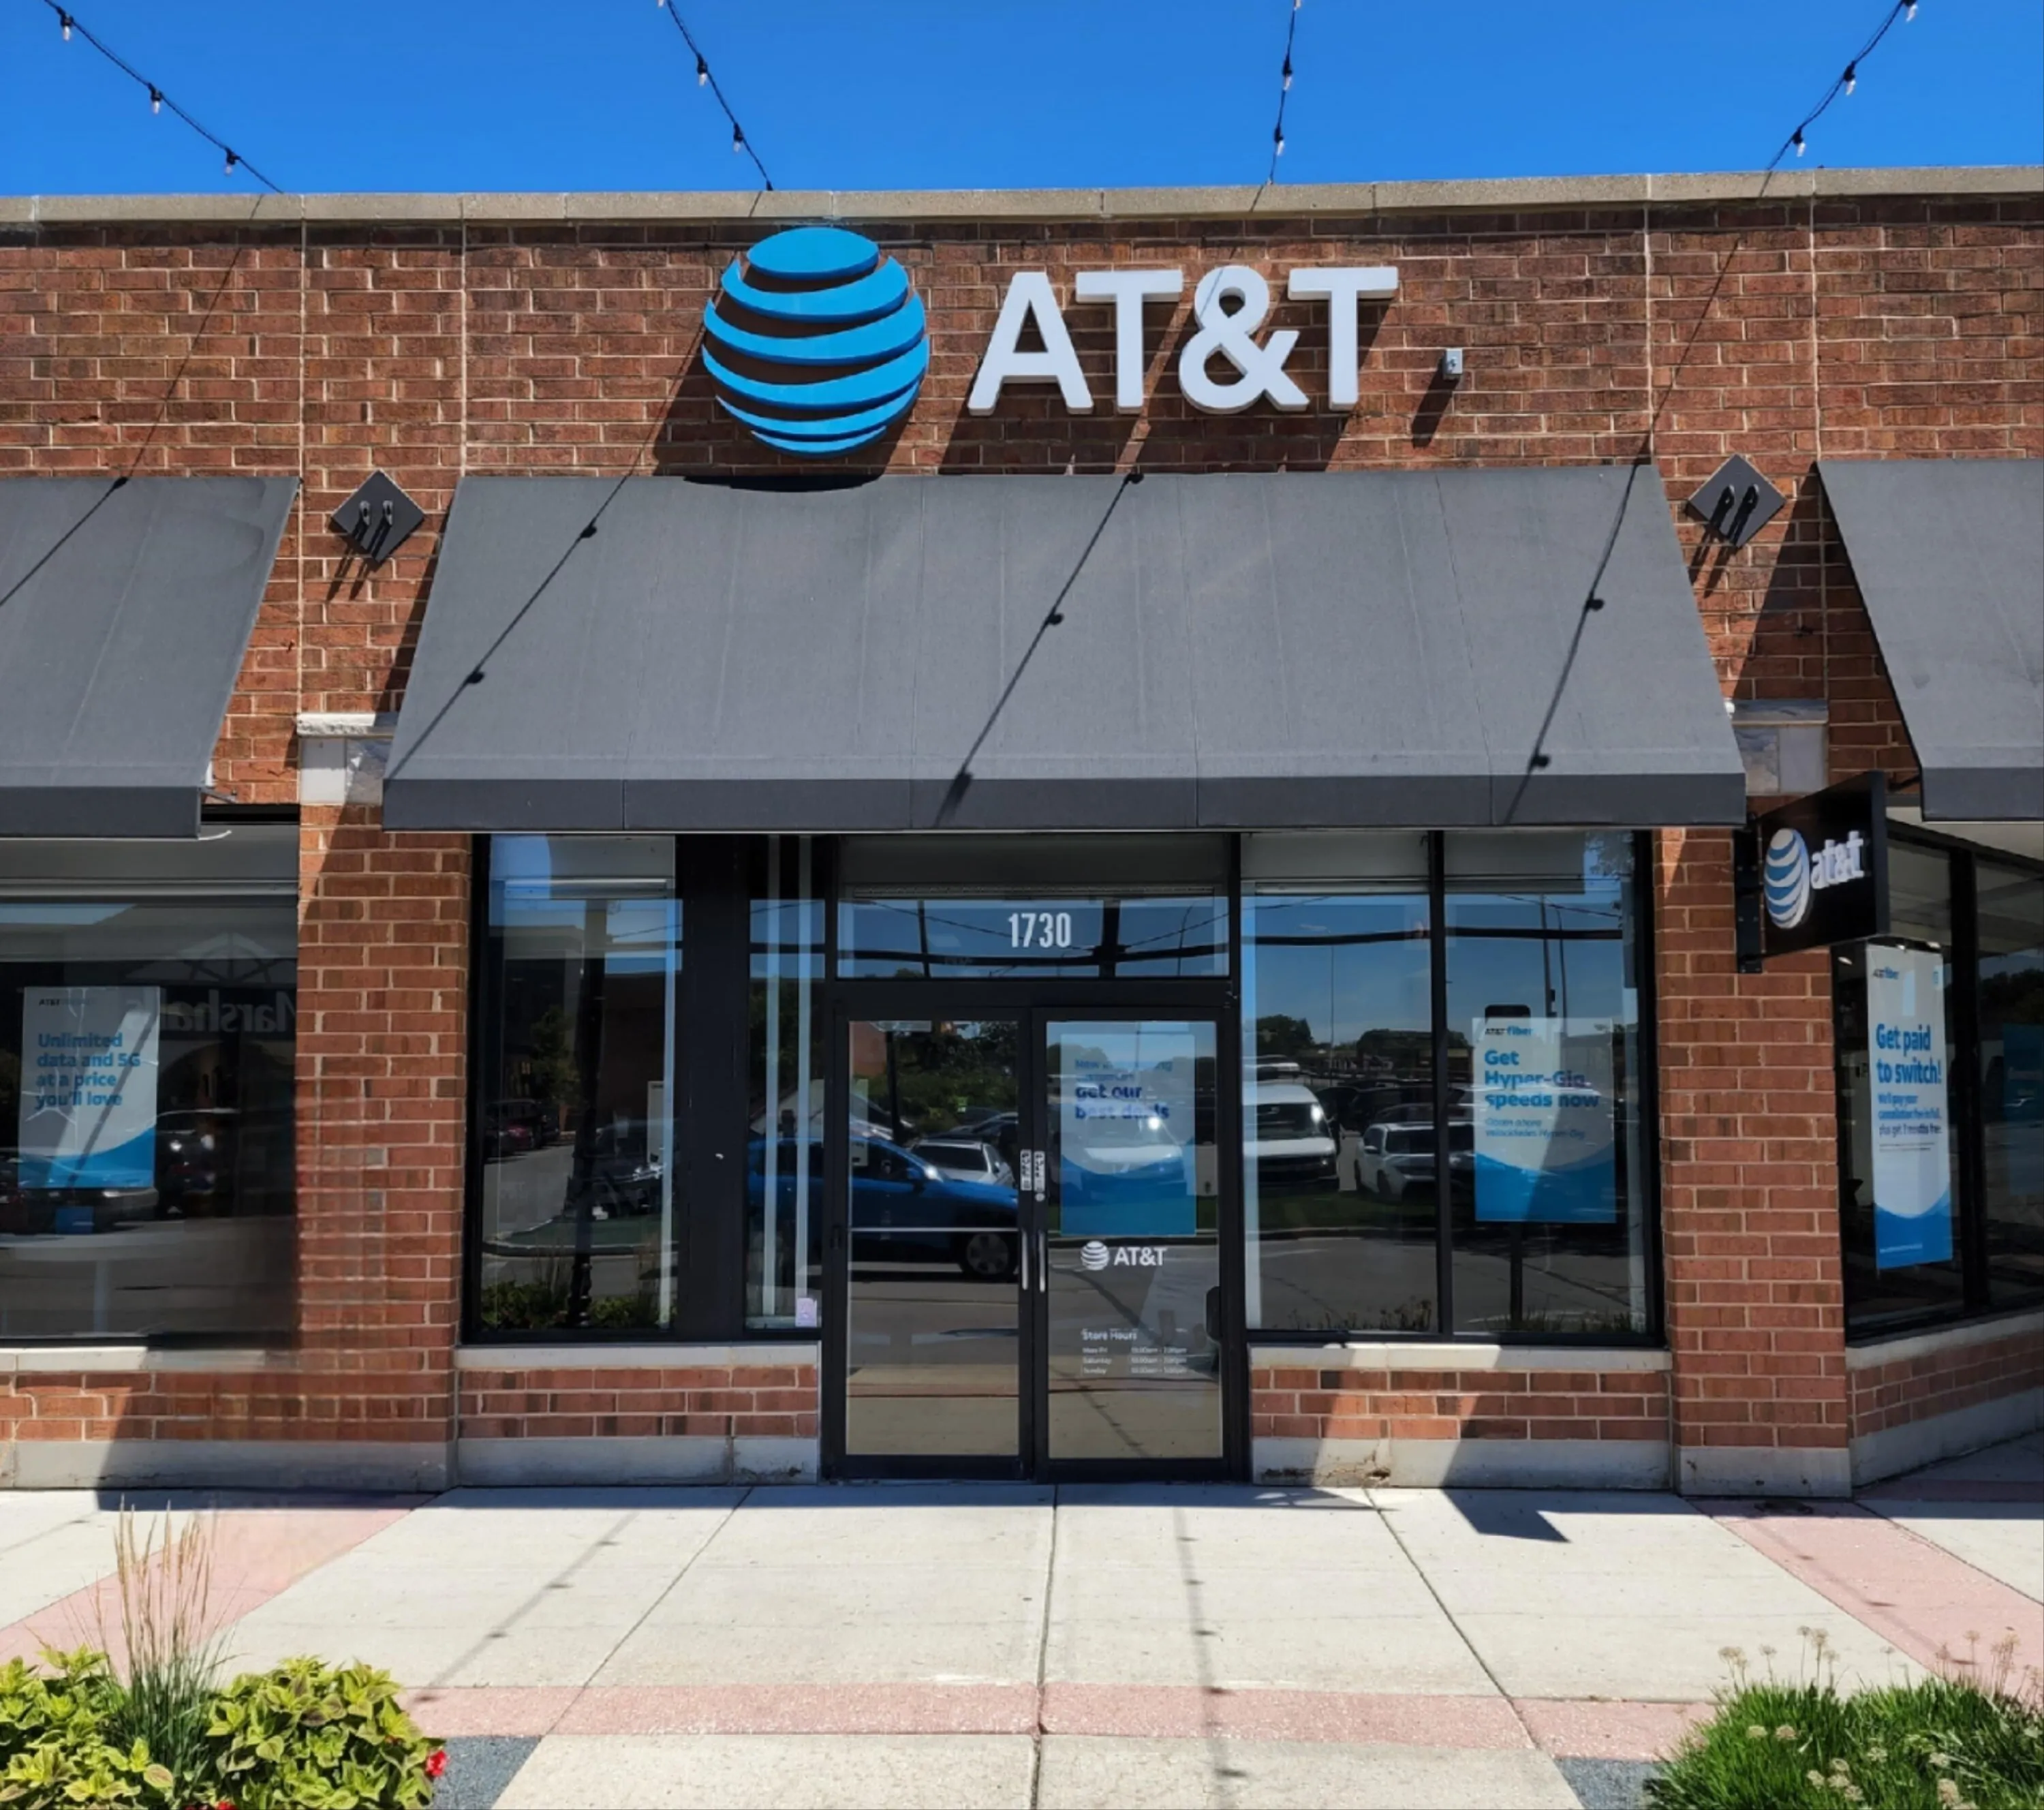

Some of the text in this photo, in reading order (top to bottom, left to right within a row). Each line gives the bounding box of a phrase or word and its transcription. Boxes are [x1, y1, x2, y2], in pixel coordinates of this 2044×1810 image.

[967, 264, 1399, 416] AT&T
[1810, 829, 1865, 890] at&t
[1008, 912, 1072, 949] 1730
[37, 1032, 123, 1048] Unlimited
[1876, 1023, 1932, 1058] Get paid
[36, 1052, 141, 1067] data and 5G
[1484, 1049, 1520, 1066] Get
[1876, 1056, 1942, 1085] to switch!
[36, 1073, 55, 1087] at
[73, 1071, 117, 1090] price
[34, 1091, 123, 1110] you'll love
[1074, 1084, 1142, 1099] Get our
[1485, 1092, 1600, 1109] speeds now
[1113, 1246, 1168, 1266] AT&T
[1082, 1330, 1138, 1340] Store Hours
